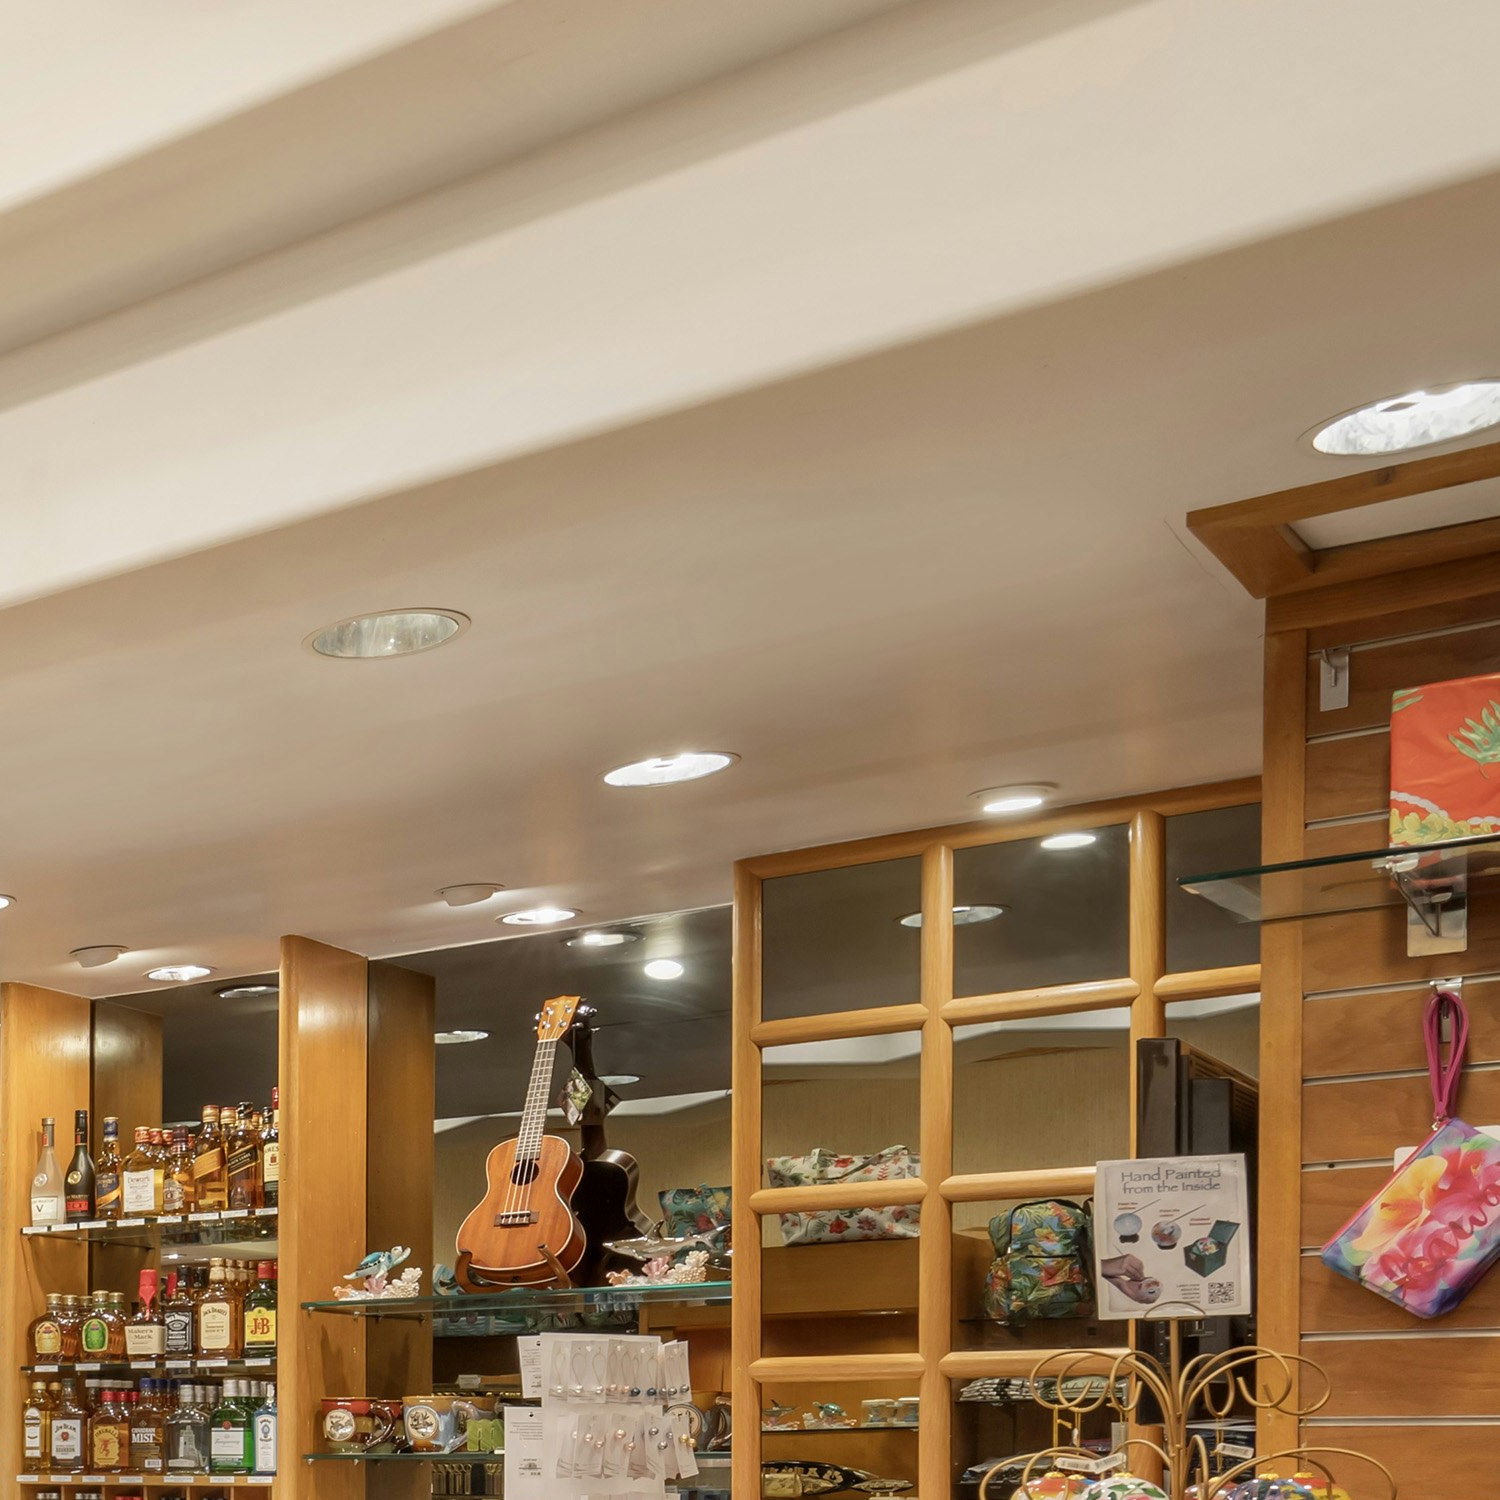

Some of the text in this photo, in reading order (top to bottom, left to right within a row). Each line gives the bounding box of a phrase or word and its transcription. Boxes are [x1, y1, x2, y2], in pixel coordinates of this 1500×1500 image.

[1121, 1164, 1221, 1182] Hand Painted
[1123, 1178, 1221, 1194] from the Inside
[132, 1434, 156, 1444] MIST
